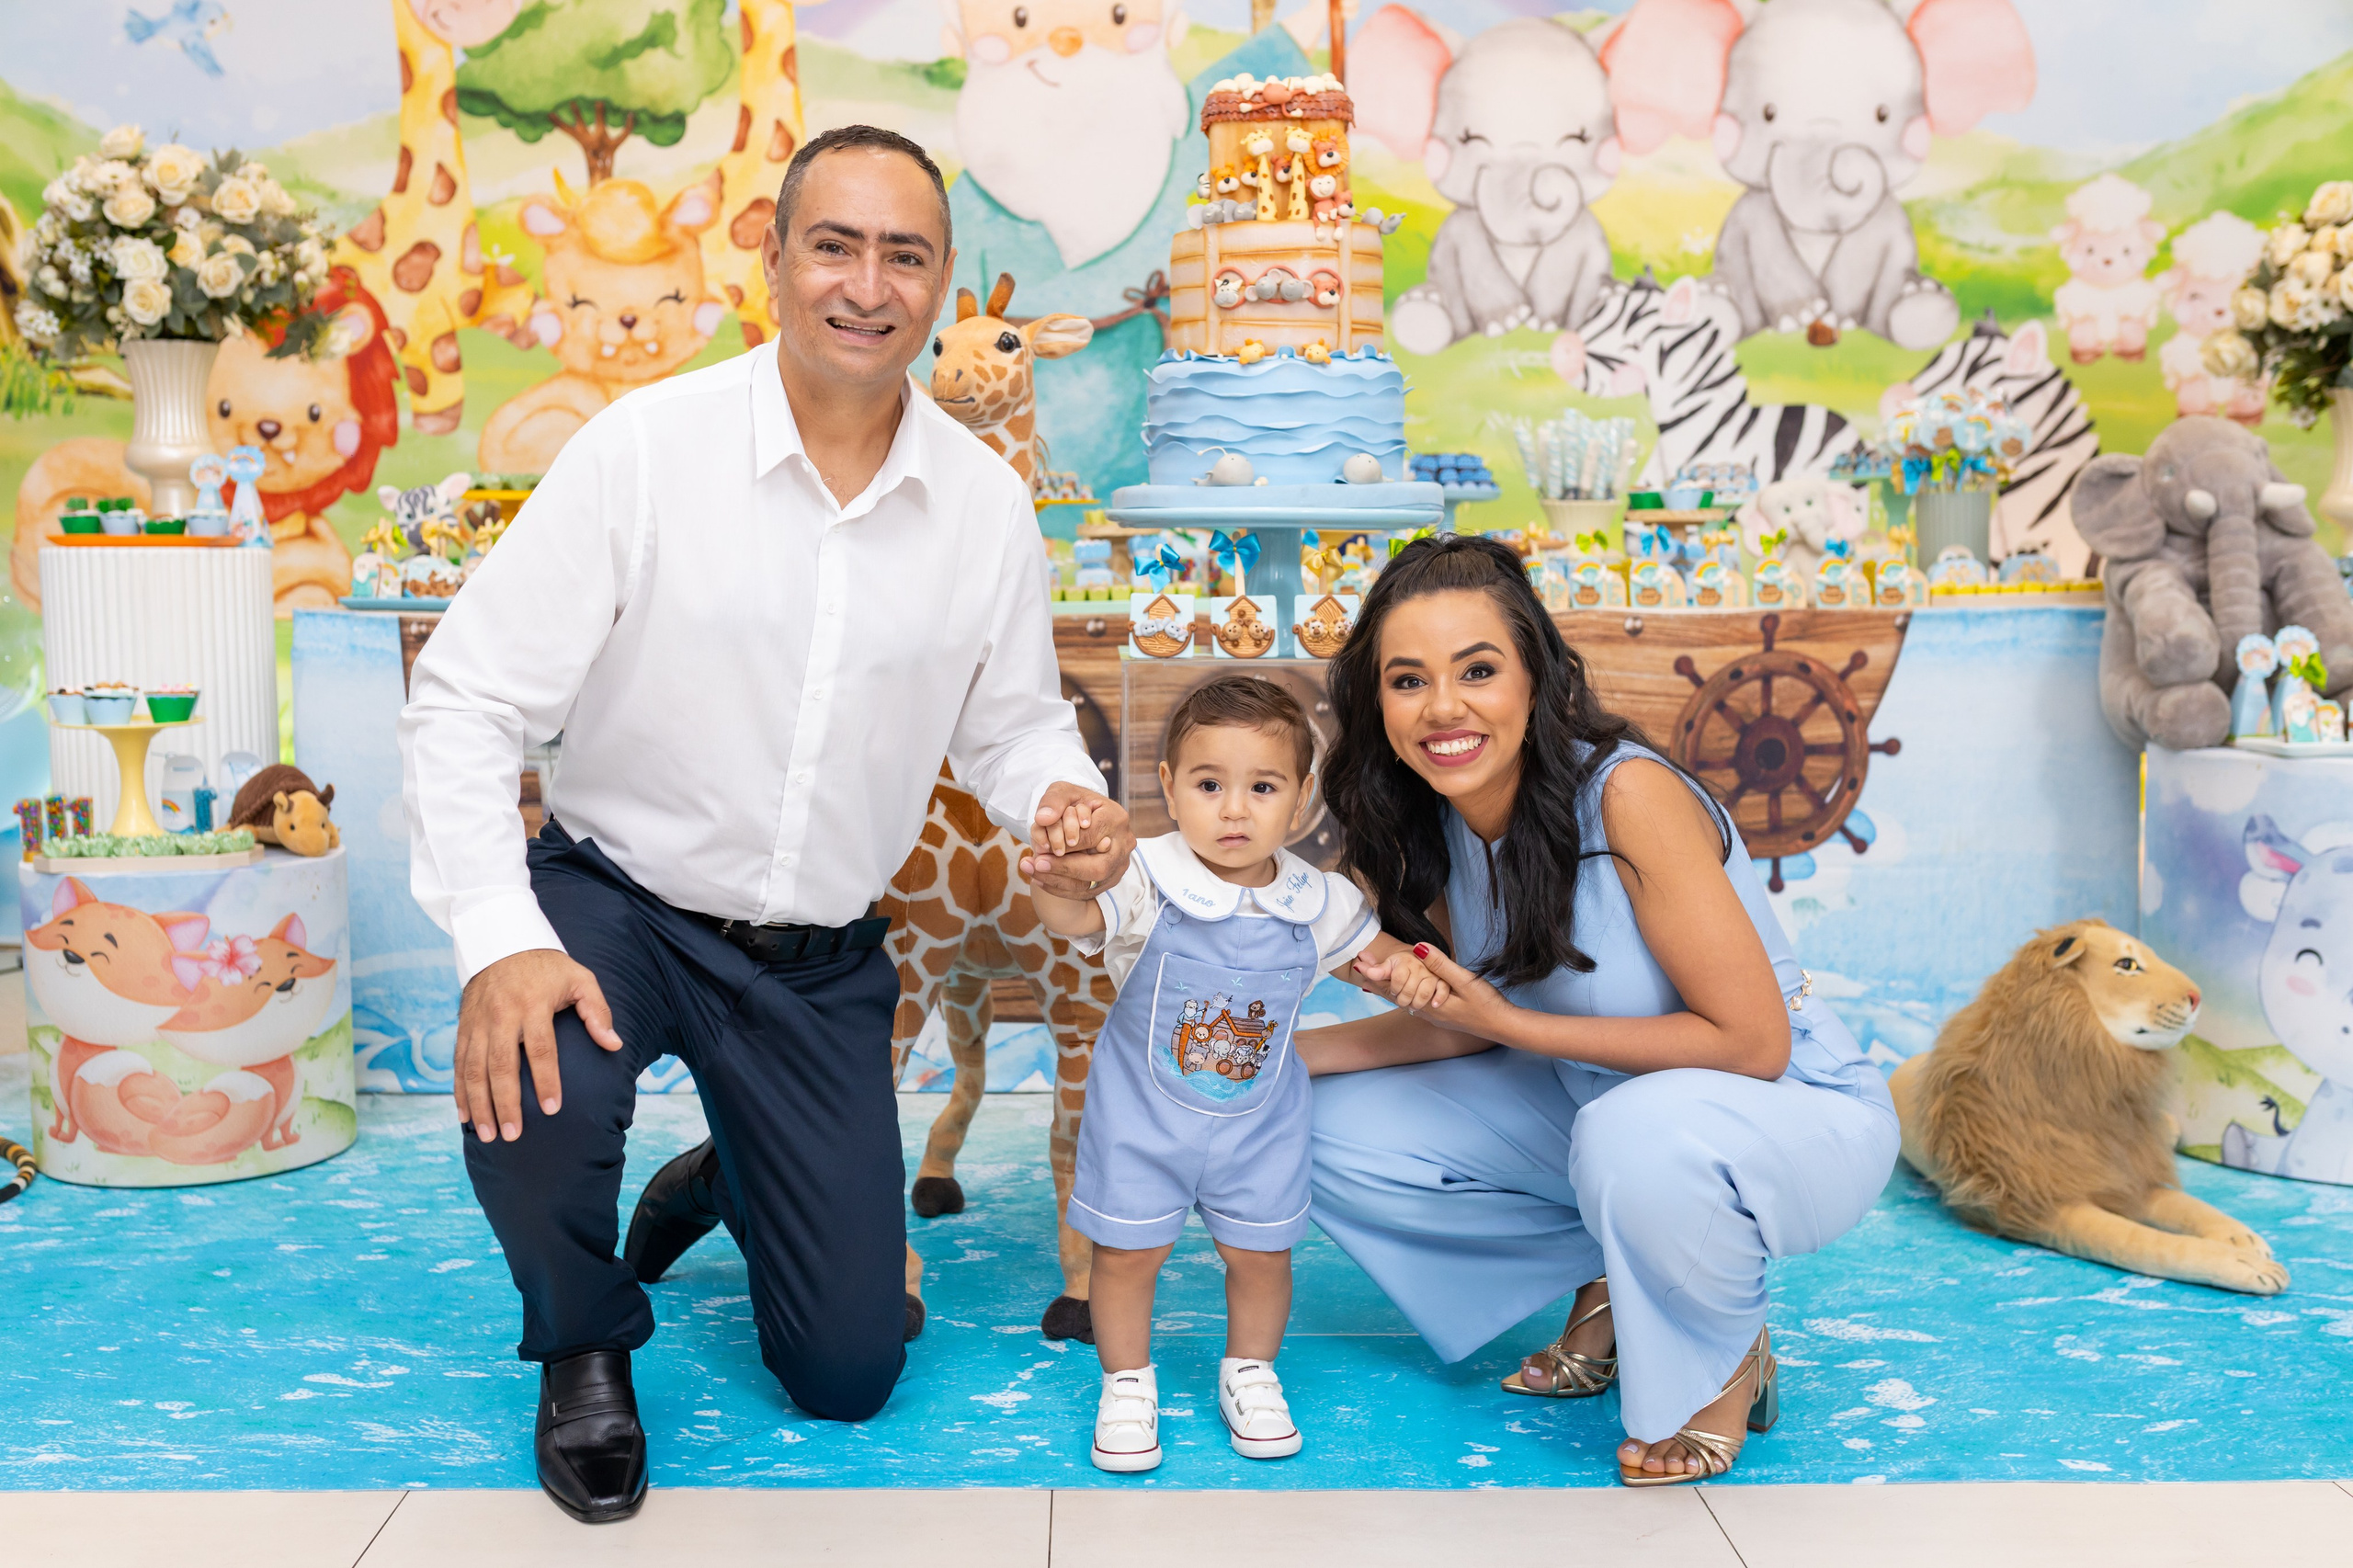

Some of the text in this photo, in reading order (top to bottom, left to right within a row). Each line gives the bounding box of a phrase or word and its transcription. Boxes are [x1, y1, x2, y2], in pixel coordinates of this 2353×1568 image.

[1286, 872, 1313, 893] Felipe
[1182, 888, 1216, 907] 1 ano
